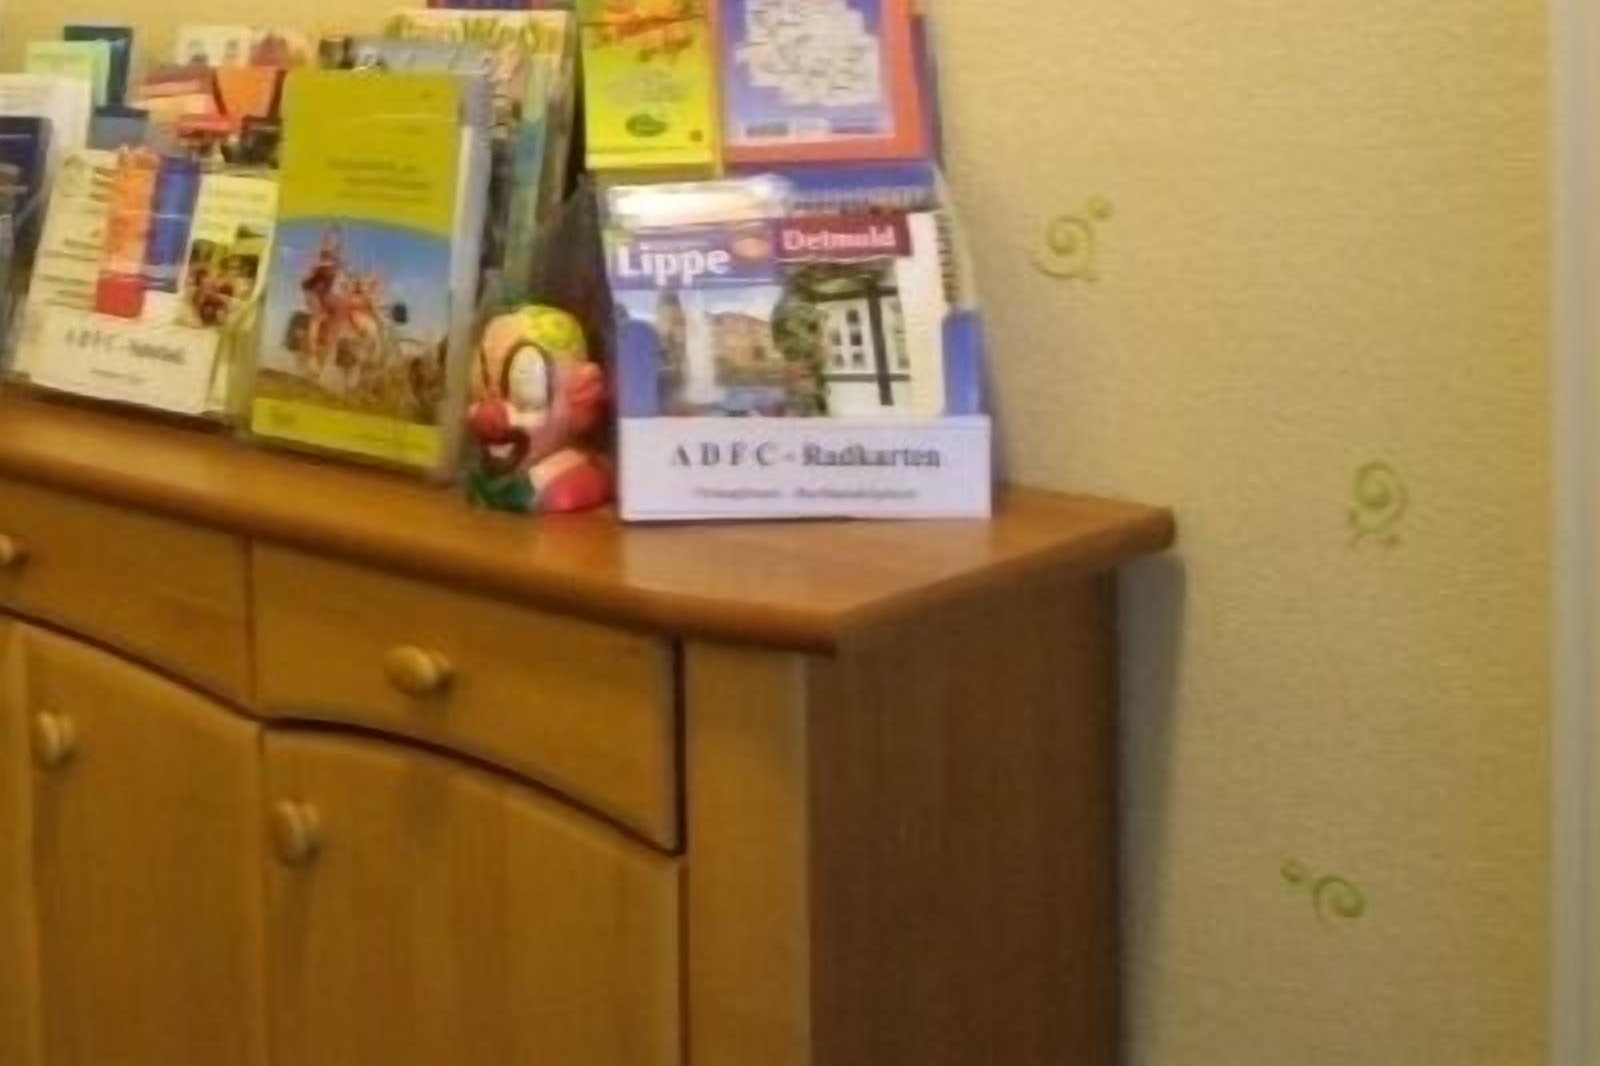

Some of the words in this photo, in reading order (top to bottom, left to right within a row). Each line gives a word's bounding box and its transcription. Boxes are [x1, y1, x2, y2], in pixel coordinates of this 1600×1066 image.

[782, 225, 898, 251] Detmold
[617, 241, 732, 284] Lippe
[802, 442, 941, 468] Radkarten
